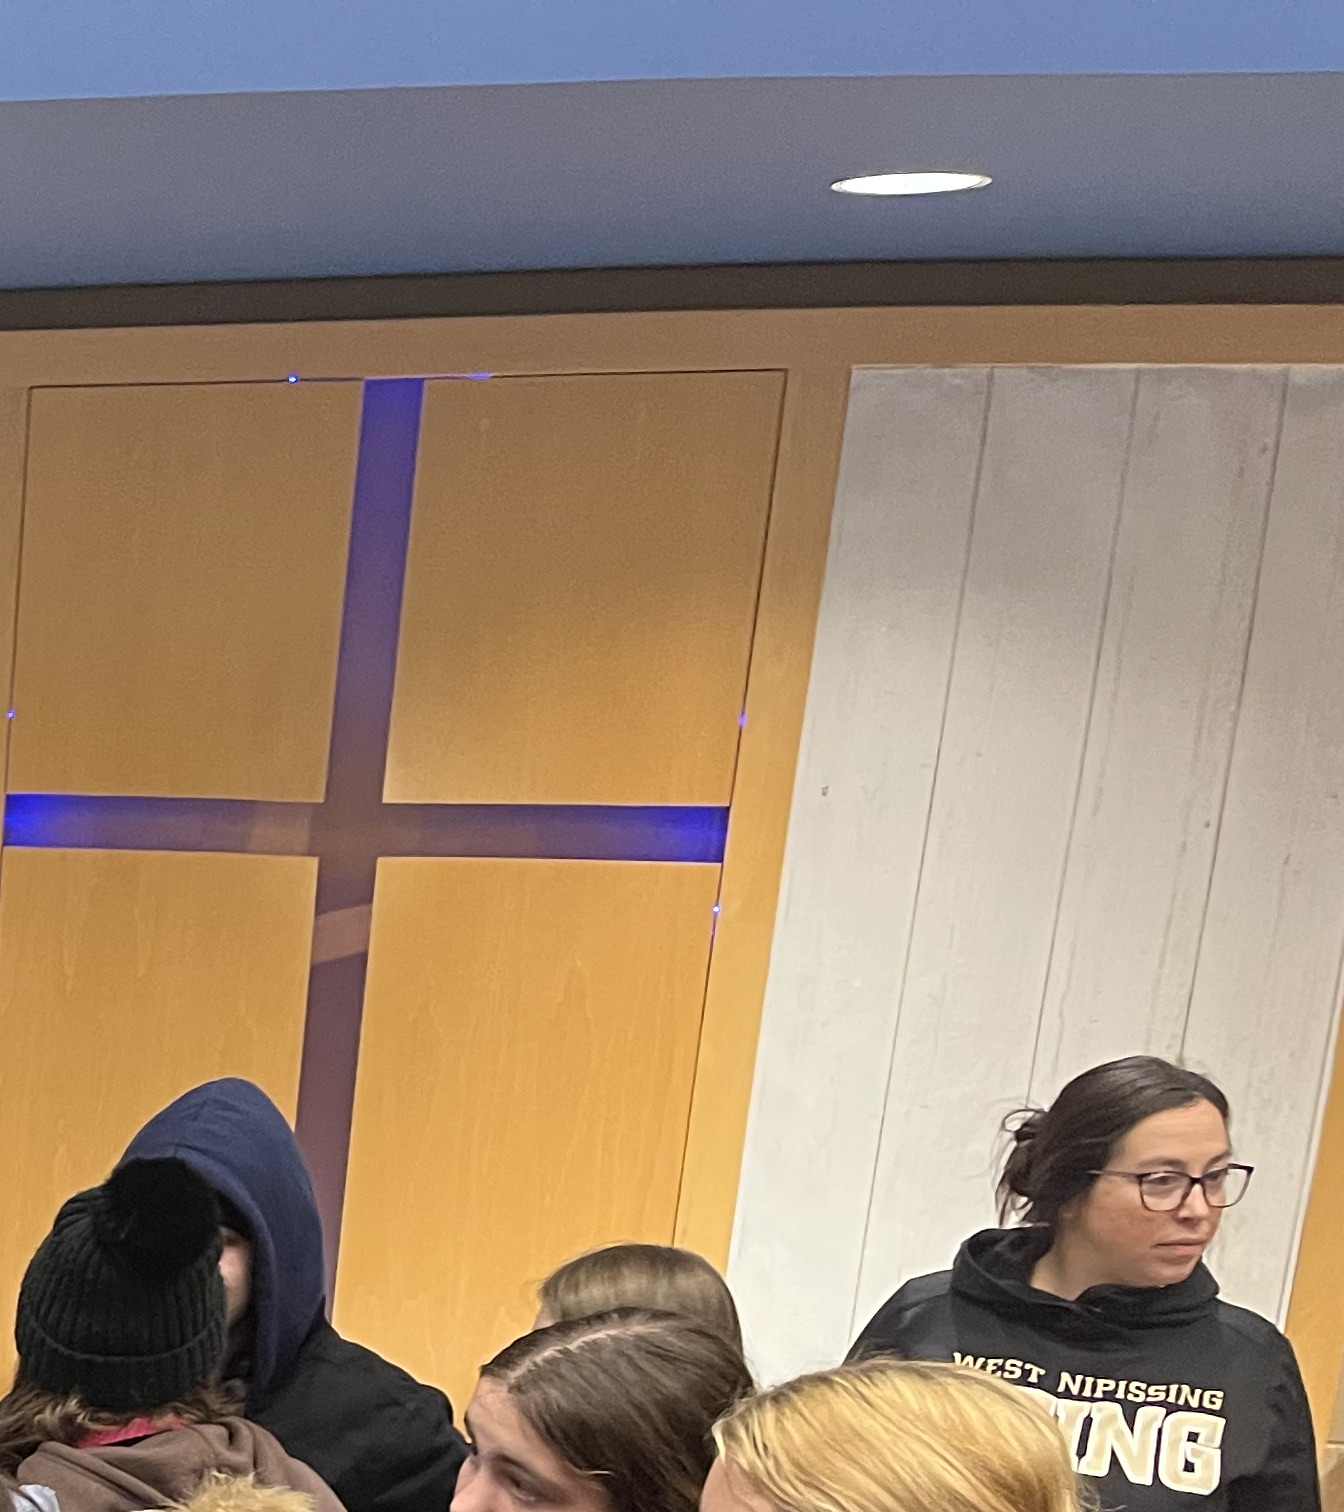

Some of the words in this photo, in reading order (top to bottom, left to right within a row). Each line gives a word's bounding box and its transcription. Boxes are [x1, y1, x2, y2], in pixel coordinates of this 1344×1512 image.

[953, 1352, 1045, 1384] WEST
[1057, 1371, 1224, 1411] NIPISSING
[1015, 1385, 1226, 1496] ING
